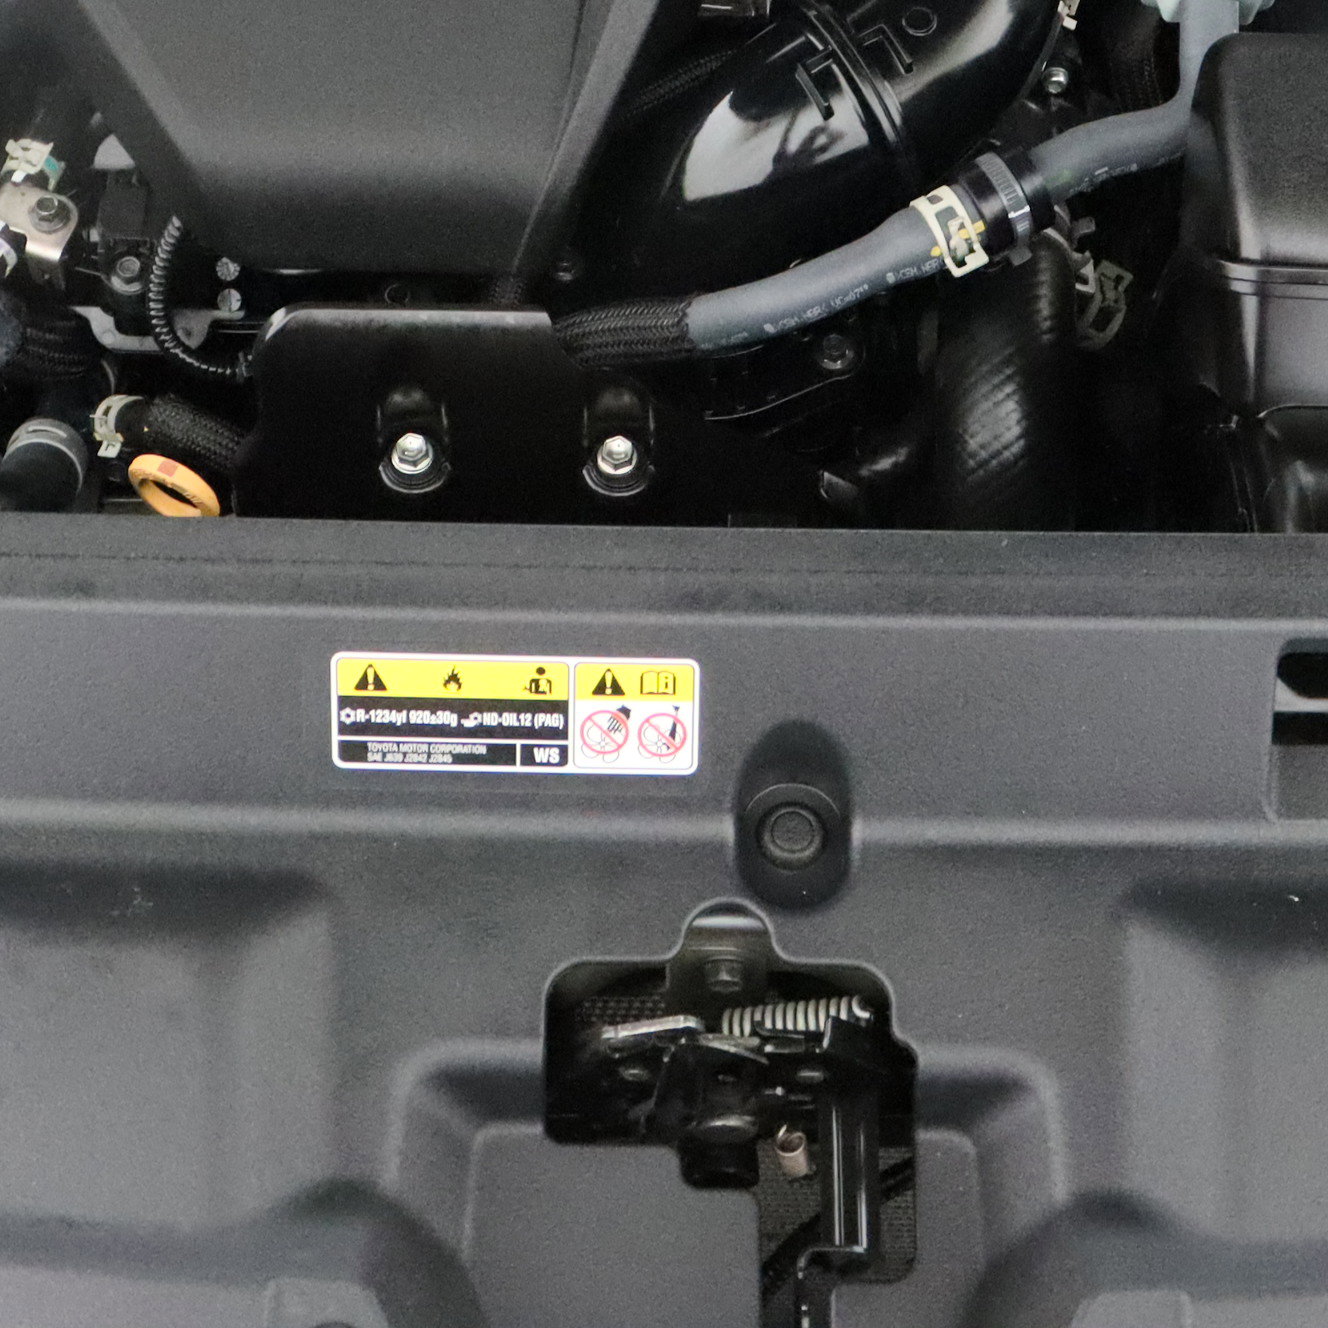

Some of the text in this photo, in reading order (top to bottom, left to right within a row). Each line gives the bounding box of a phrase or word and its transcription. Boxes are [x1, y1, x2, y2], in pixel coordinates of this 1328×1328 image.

[356, 708, 407, 726] R-1234yf
[409, 709, 458, 728] 920±30g
[534, 712, 564, 729] (PAG)
[367, 742, 487, 755] TOYOTA MOTOR CORPORATION
[533, 747, 560, 764] WS
[367, 753, 383, 762] SAE
